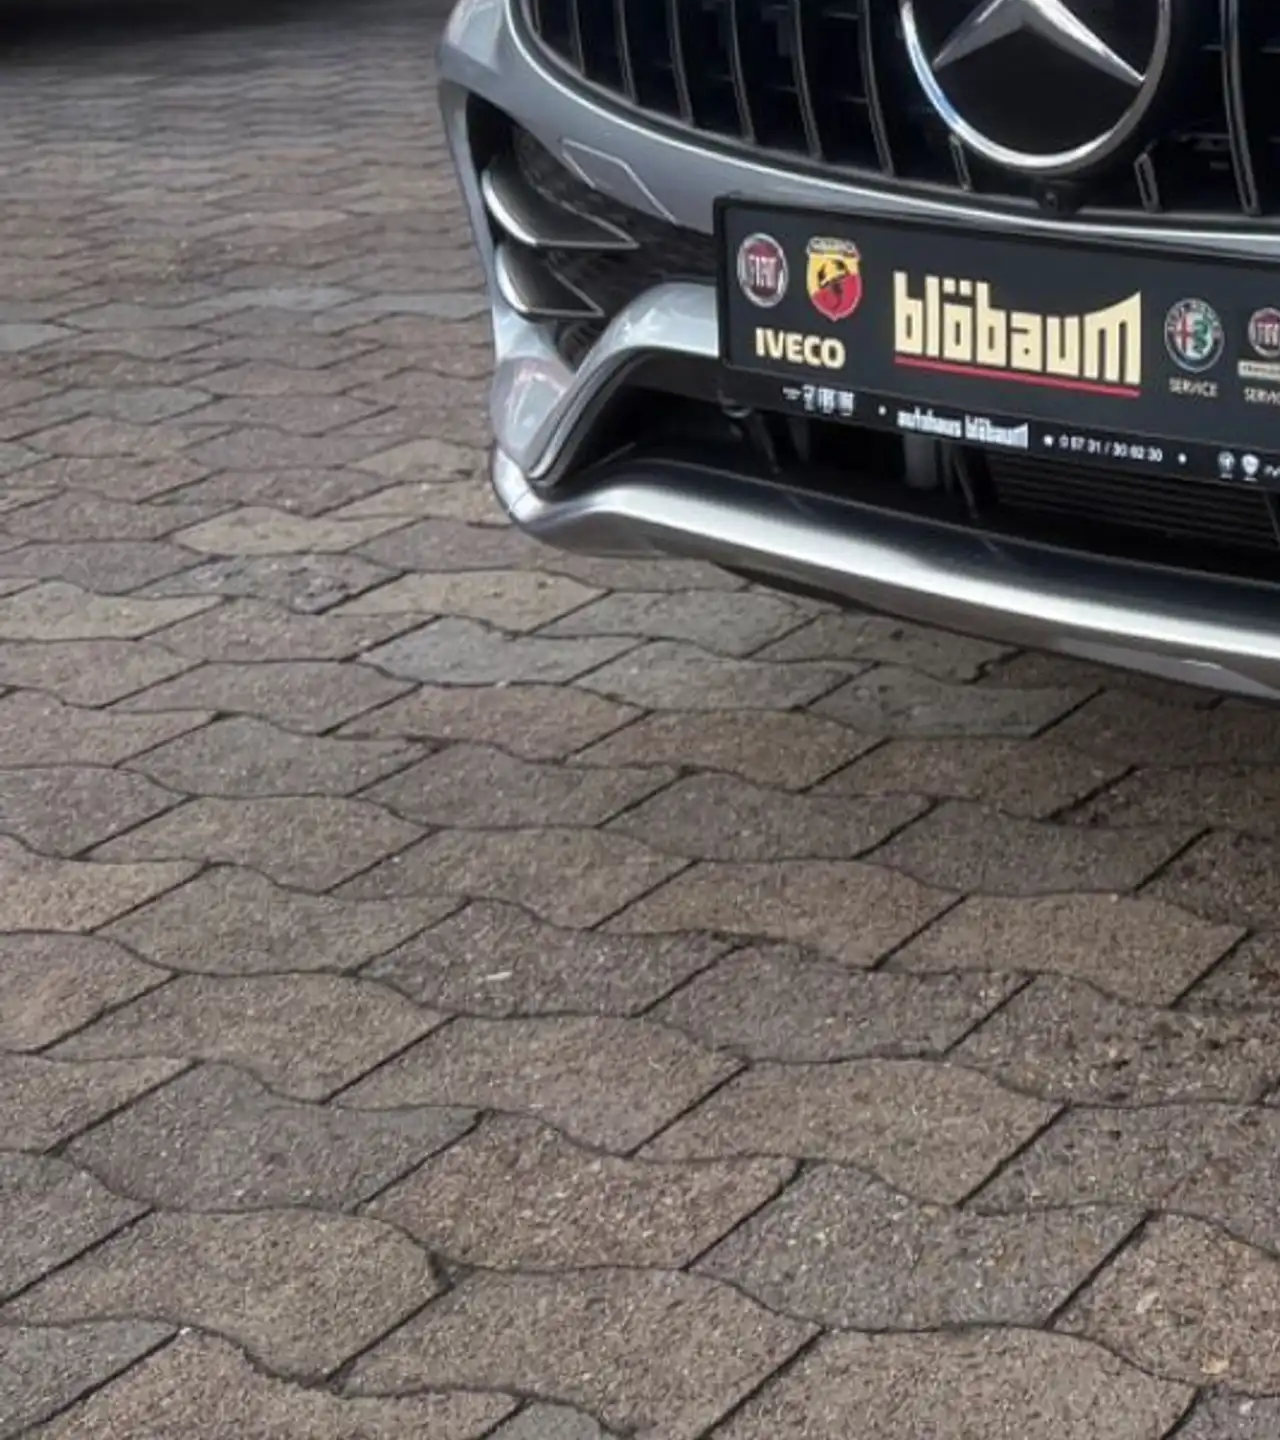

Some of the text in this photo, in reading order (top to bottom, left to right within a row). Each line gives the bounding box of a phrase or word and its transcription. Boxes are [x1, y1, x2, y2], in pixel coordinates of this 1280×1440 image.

[755, 327, 846, 369] IVECO
[893, 271, 1142, 385] blöbaum
[1168, 376, 1219, 398] SERVICE
